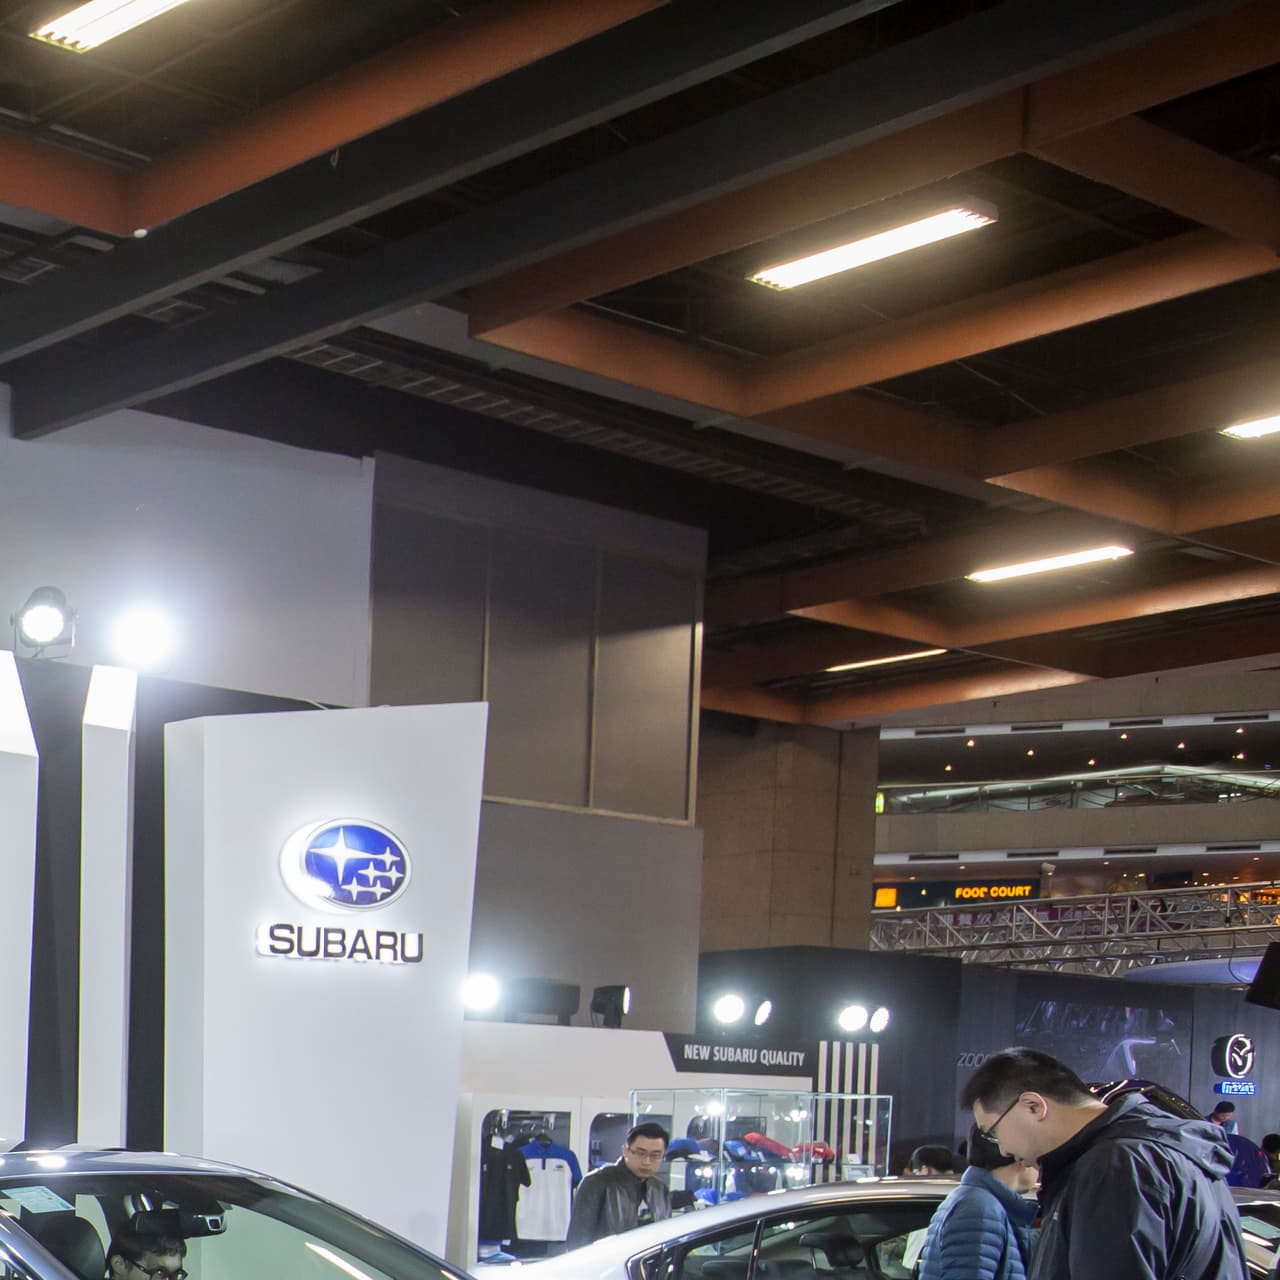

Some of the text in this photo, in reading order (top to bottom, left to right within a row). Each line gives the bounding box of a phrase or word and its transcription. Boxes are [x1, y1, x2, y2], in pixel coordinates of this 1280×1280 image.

[990, 886, 1032, 897] COURT
[269, 923, 424, 963] SUBARU
[684, 1044, 805, 1066] NEW SUBARU QUALITY
